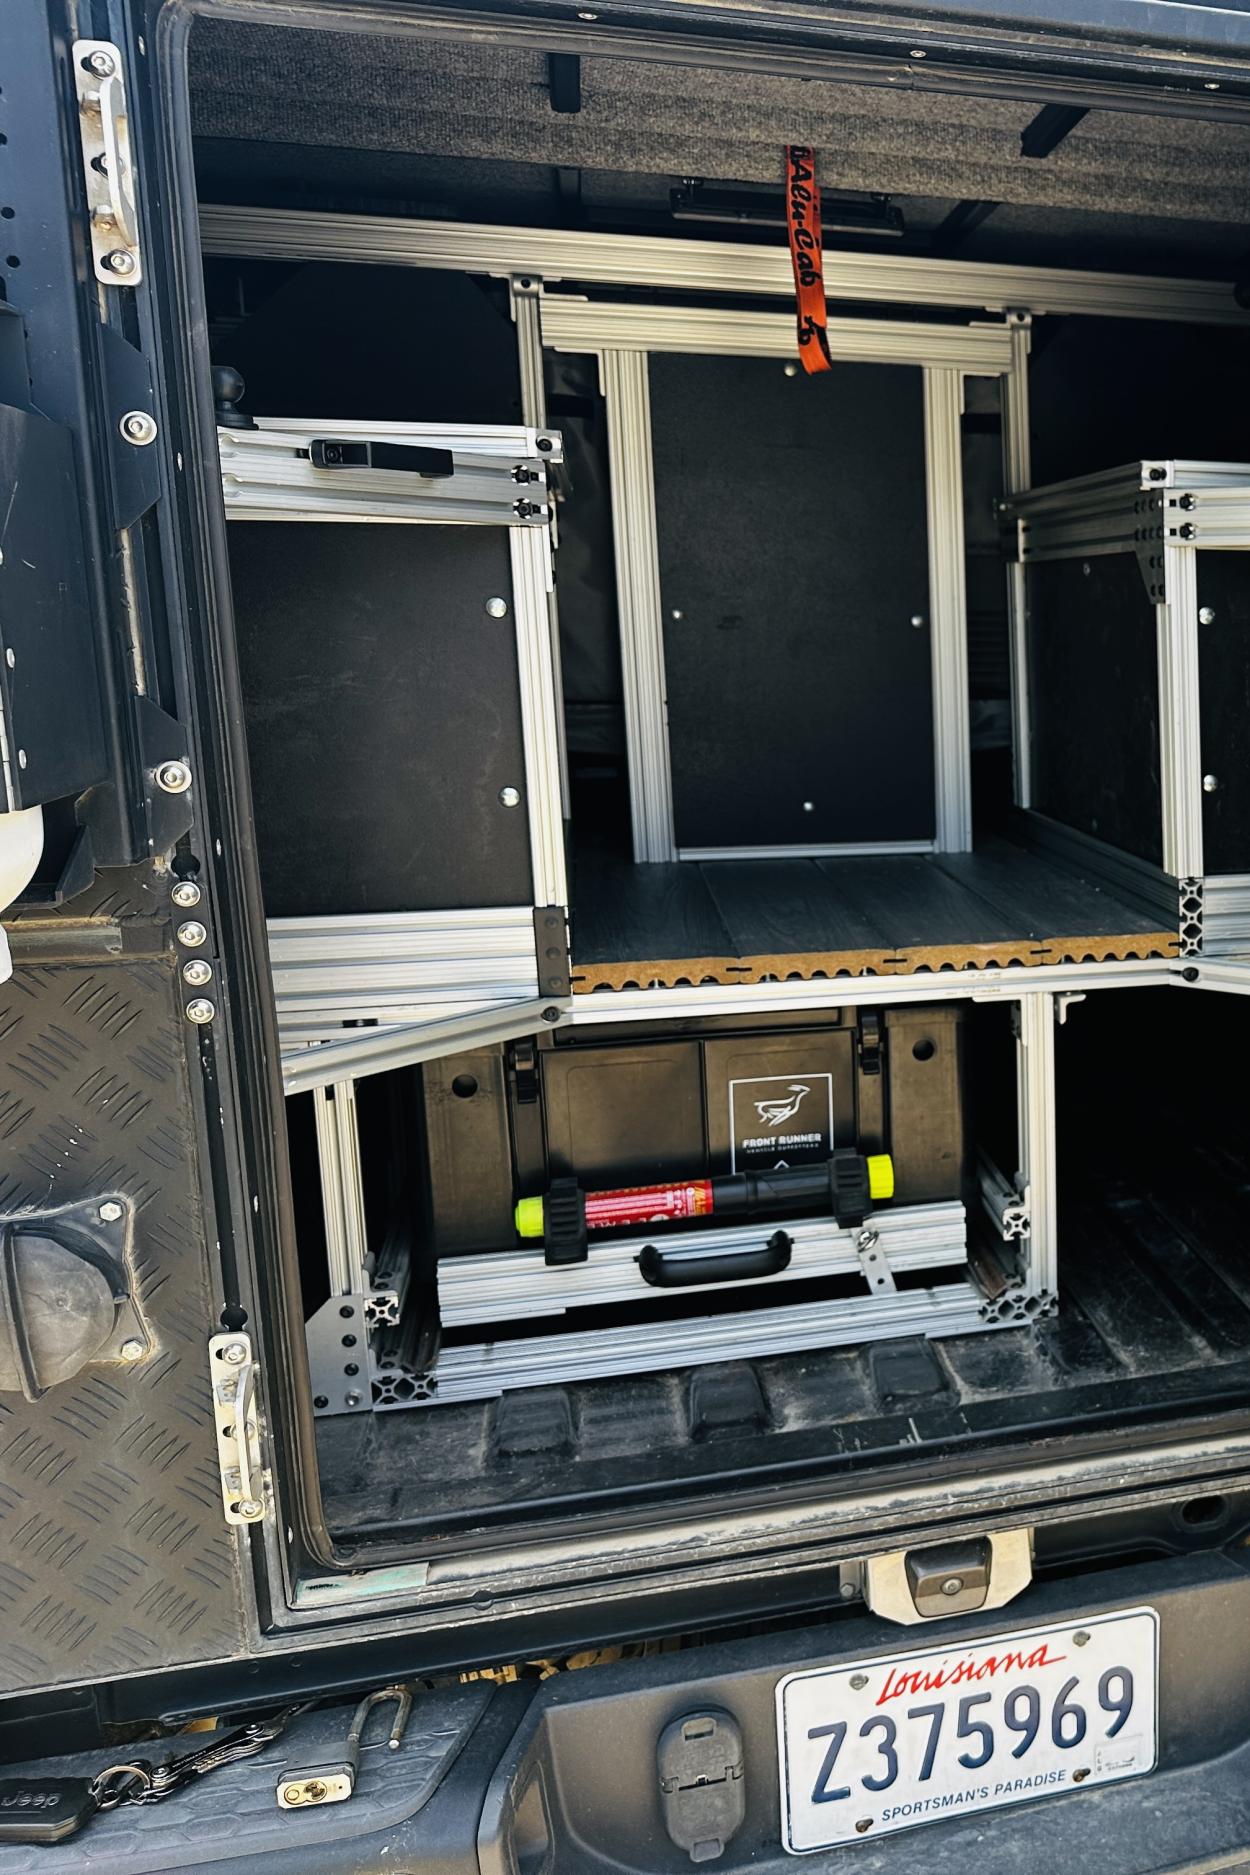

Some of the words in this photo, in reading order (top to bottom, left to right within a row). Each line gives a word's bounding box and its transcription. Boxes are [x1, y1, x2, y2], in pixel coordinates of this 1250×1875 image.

[790, 160, 821, 288] Alu-Cab
[742, 1136, 776, 1149] FRONT
[778, 1133, 822, 1145] RUNNER
[876, 1643, 1066, 1706] Louisiana
[808, 1665, 1134, 1804] Z375969
[881, 1785, 990, 1822] SPORTSMAN'S
[994, 1769, 1067, 1796] PARADISE
